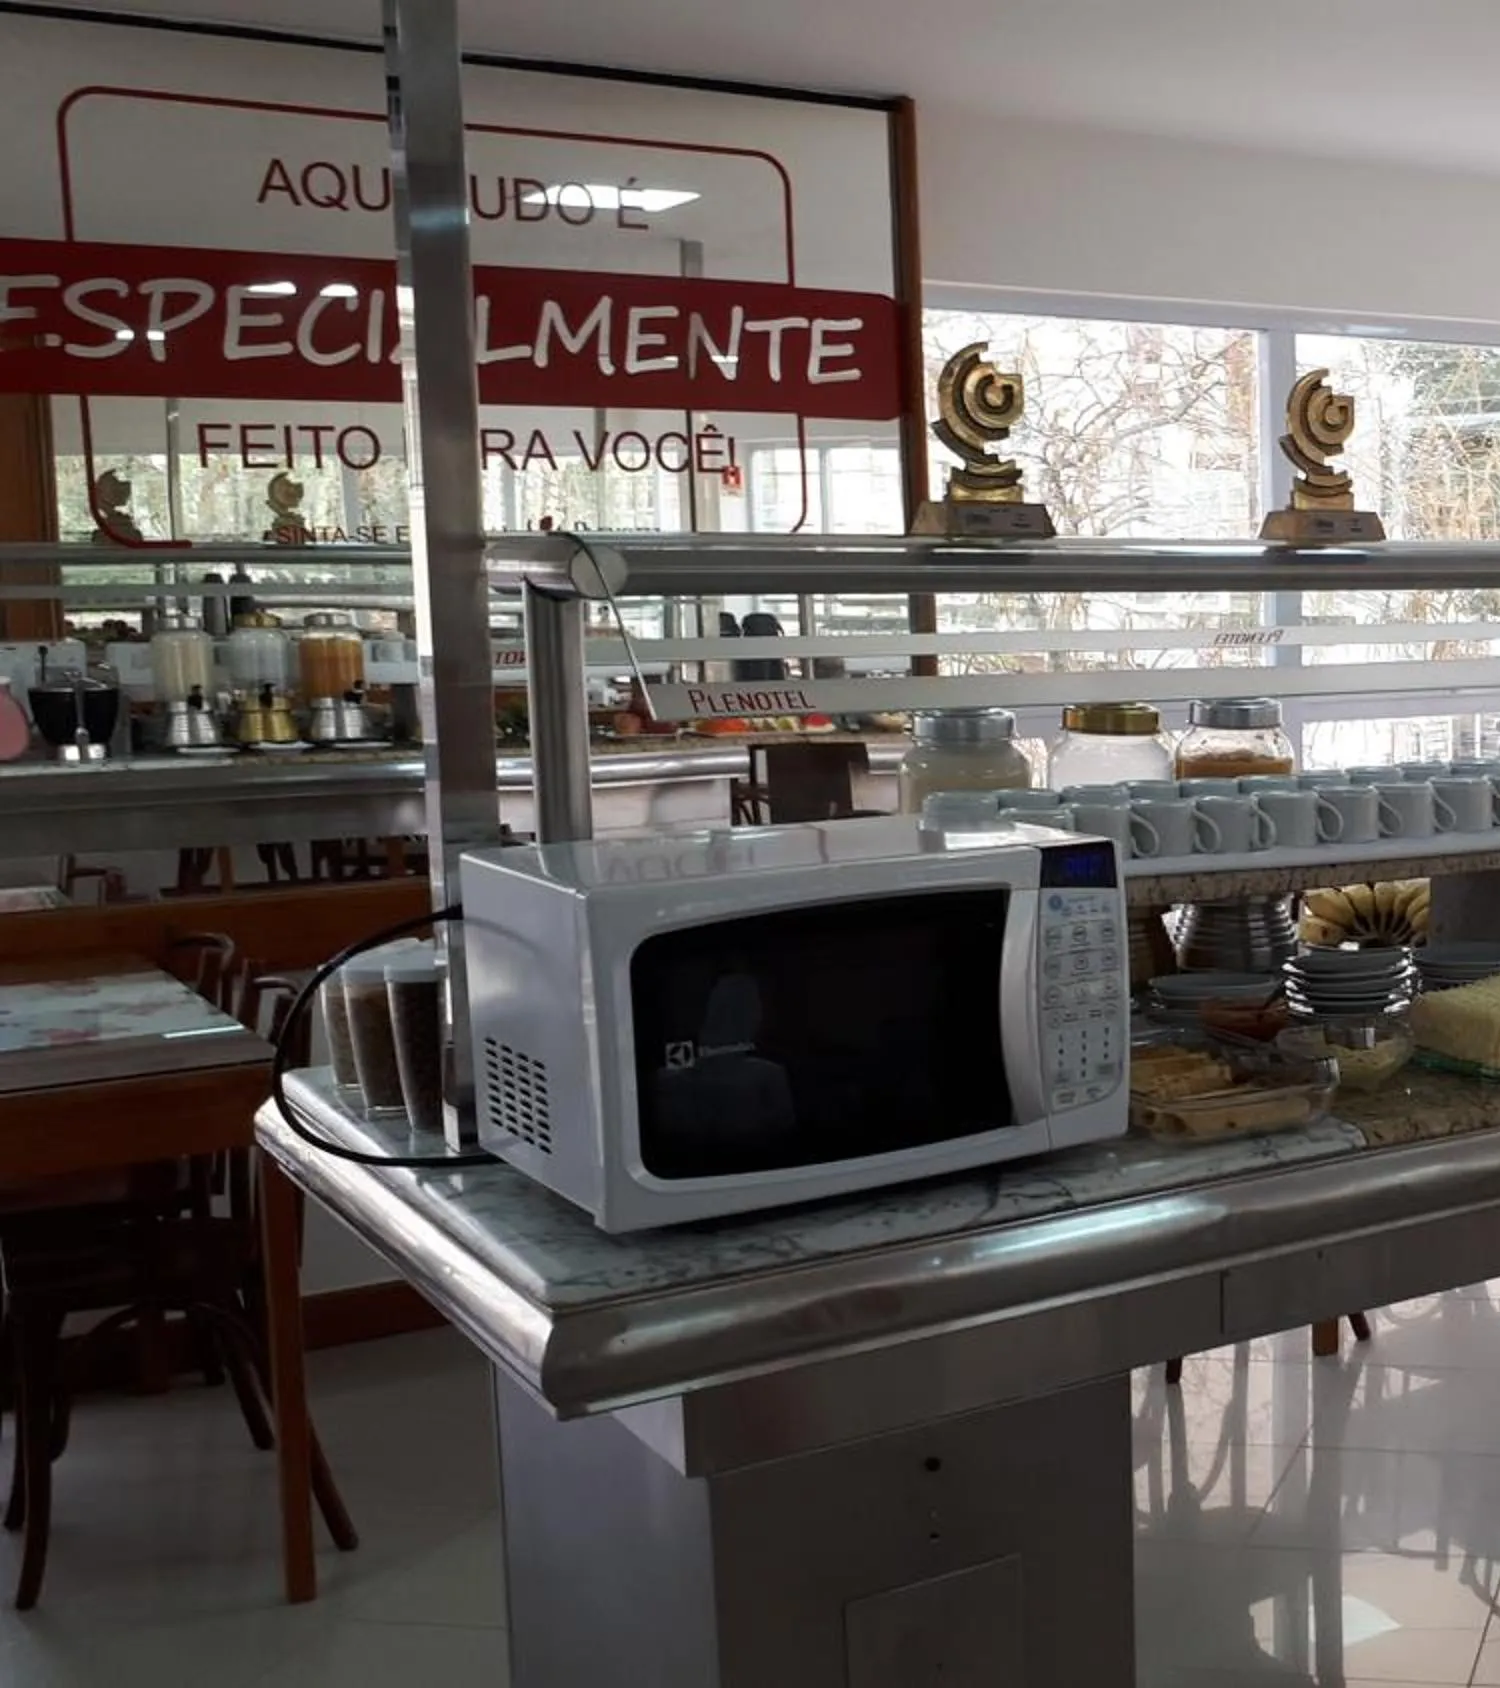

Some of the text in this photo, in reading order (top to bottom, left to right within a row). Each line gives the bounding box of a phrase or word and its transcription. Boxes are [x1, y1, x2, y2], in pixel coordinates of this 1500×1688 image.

[257, 158, 649, 230] AQU UDO É
[0, 274, 863, 384] ESPECILMENTE
[196, 423, 737, 476] FEITO RA VOCÊ!
[687, 688, 816, 714] PLENOTEL
